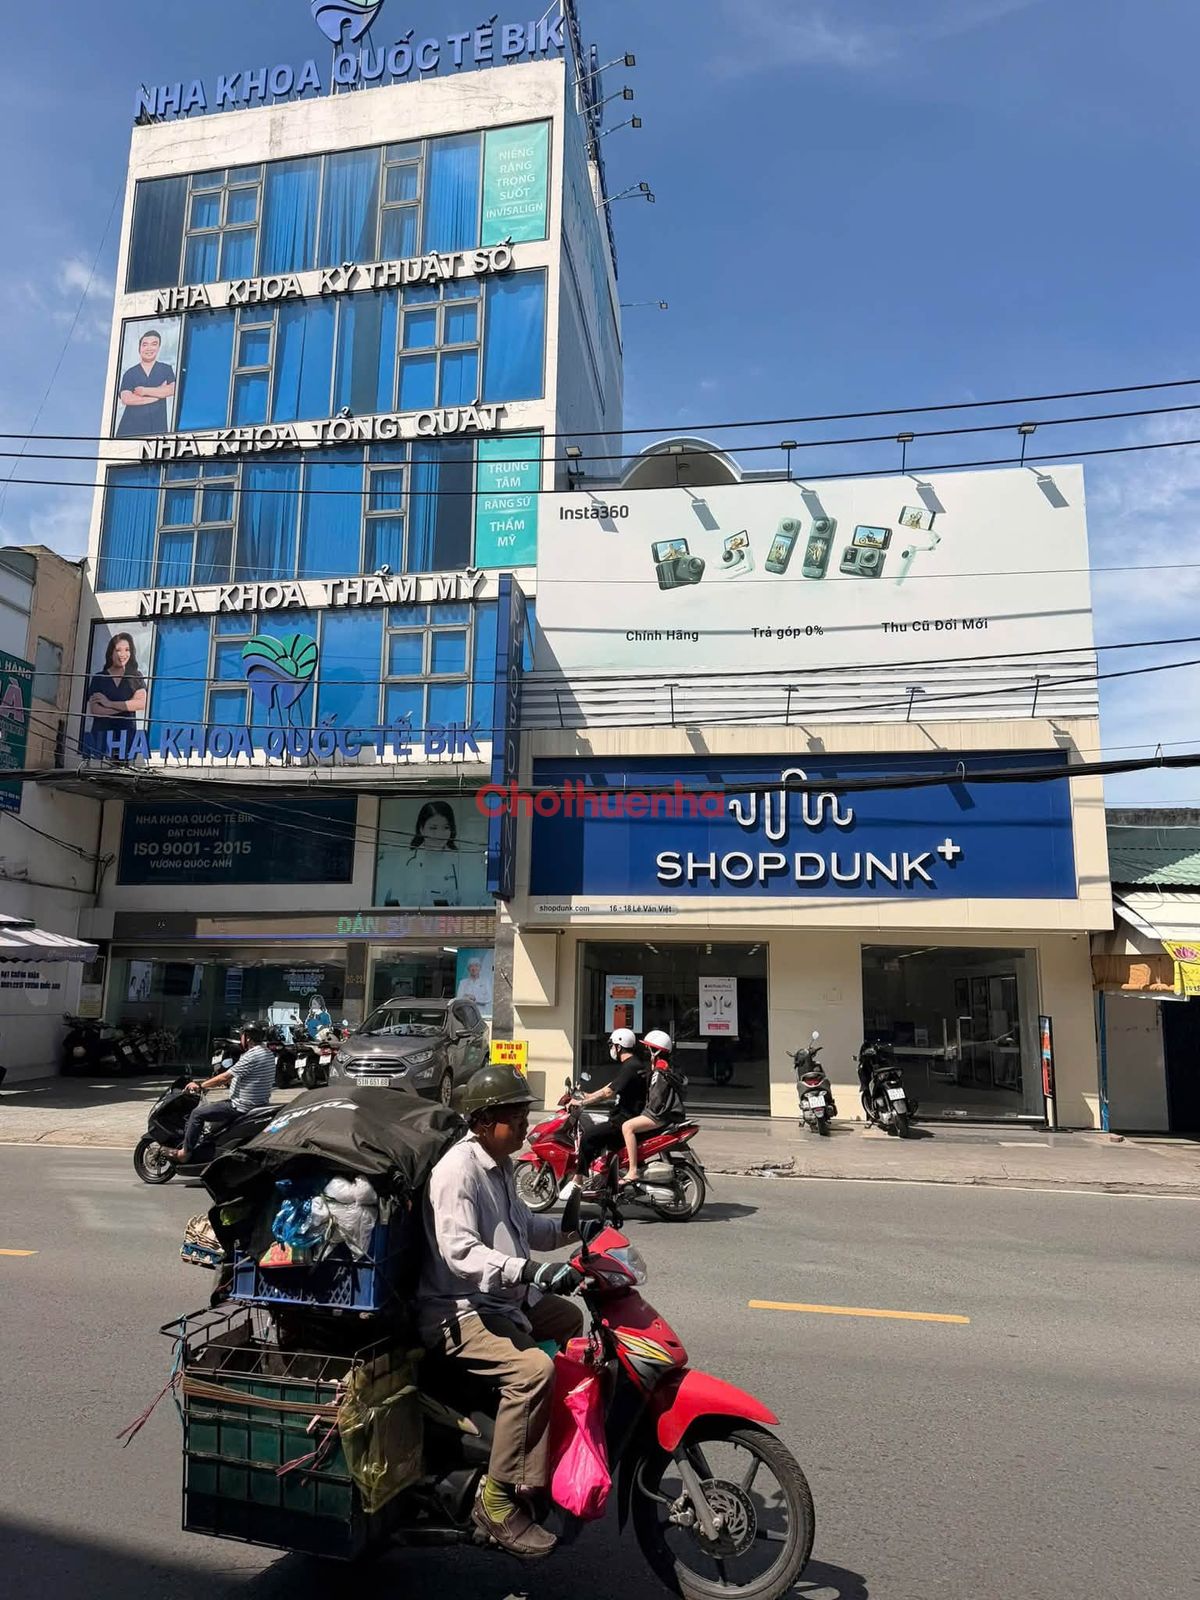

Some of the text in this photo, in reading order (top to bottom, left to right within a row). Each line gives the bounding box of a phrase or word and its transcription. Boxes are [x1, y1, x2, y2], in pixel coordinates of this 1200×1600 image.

[134, 14, 566, 118] NHA KHOA QUỐC TẾ BIK
[497, 174, 535, 187] TRONG
[486, 202, 543, 219] INVISALIGN
[154, 235, 514, 312] NHA KHOA KỸ THUẬT SỐ
[139, 399, 505, 460] NHA KHOA TỔNG QUÁT
[488, 461, 529, 473] TRUNG
[559, 505, 629, 520] Insta360
[137, 563, 484, 616] NHA KHOA THẨM MỸ
[751, 625, 824, 640] Trả góp 0%
[881, 617, 988, 633] Thu Cũ Đổi Mới
[625, 630, 662, 642] Chính
[160, 727, 254, 759] KHOA
[263, 713, 363, 759] QUỐC
[376, 710, 413, 756] TẾ
[424, 720, 481, 754] BIK
[135, 815, 157, 825] NHA
[159, 814, 189, 824] KHOA
[134, 842, 159, 855] ISO
[162, 842, 200, 855] 9001
[214, 841, 252, 855] 2015
[211, 858, 232, 868] ANH
[539, 904, 590, 913] shopdunk.com
